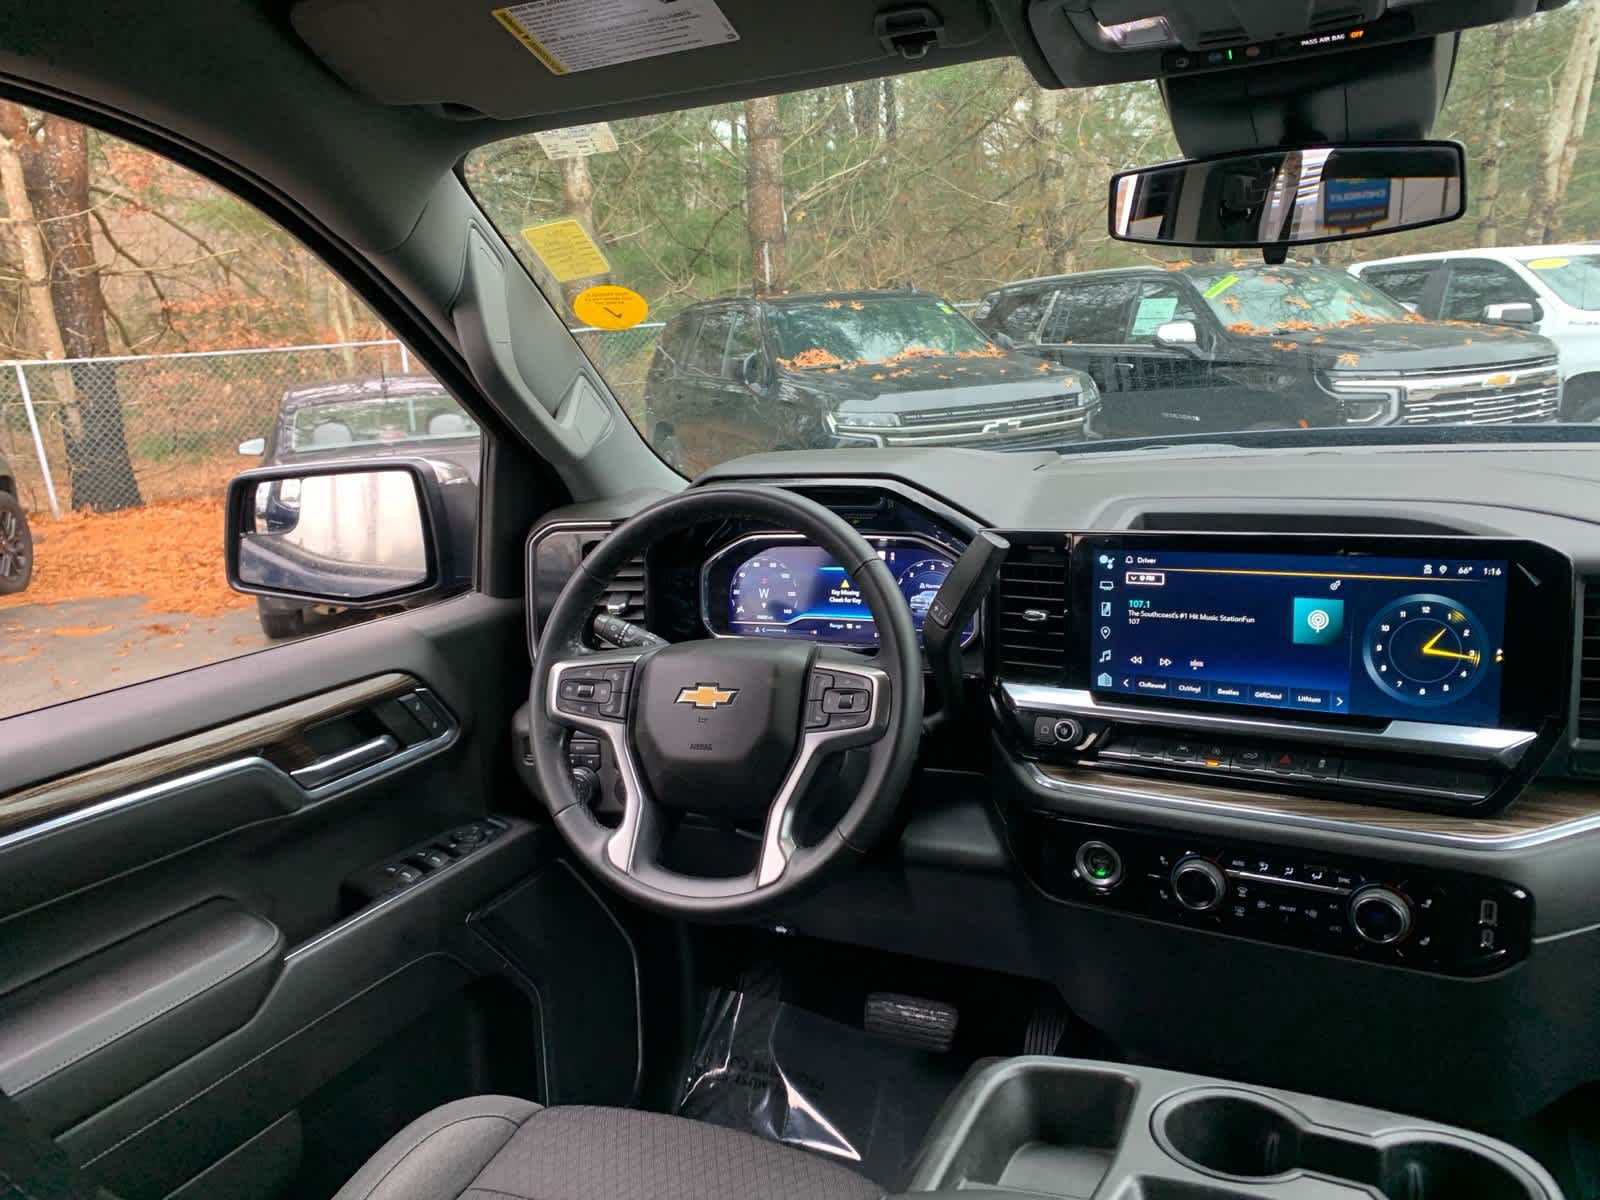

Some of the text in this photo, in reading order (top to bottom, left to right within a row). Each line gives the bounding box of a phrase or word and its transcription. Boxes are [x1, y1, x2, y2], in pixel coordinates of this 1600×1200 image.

[1301, 38, 1318, 46] PASS
[1331, 33, 1345, 41] BAG
[1350, 30, 1364, 38] OFF
[1137, 556, 1156, 564] Driver
[1483, 567, 1502, 576] 1:16
[758, 587, 770, 600] W
[1128, 599, 1151, 609] 107.1
[1128, 609, 1140, 617] The
[1140, 610, 1179, 619] Southcoast's
[1179, 612, 1188, 620] #1
[1189, 612, 1199, 620] Hit
[1199, 613, 1218, 622] Music
